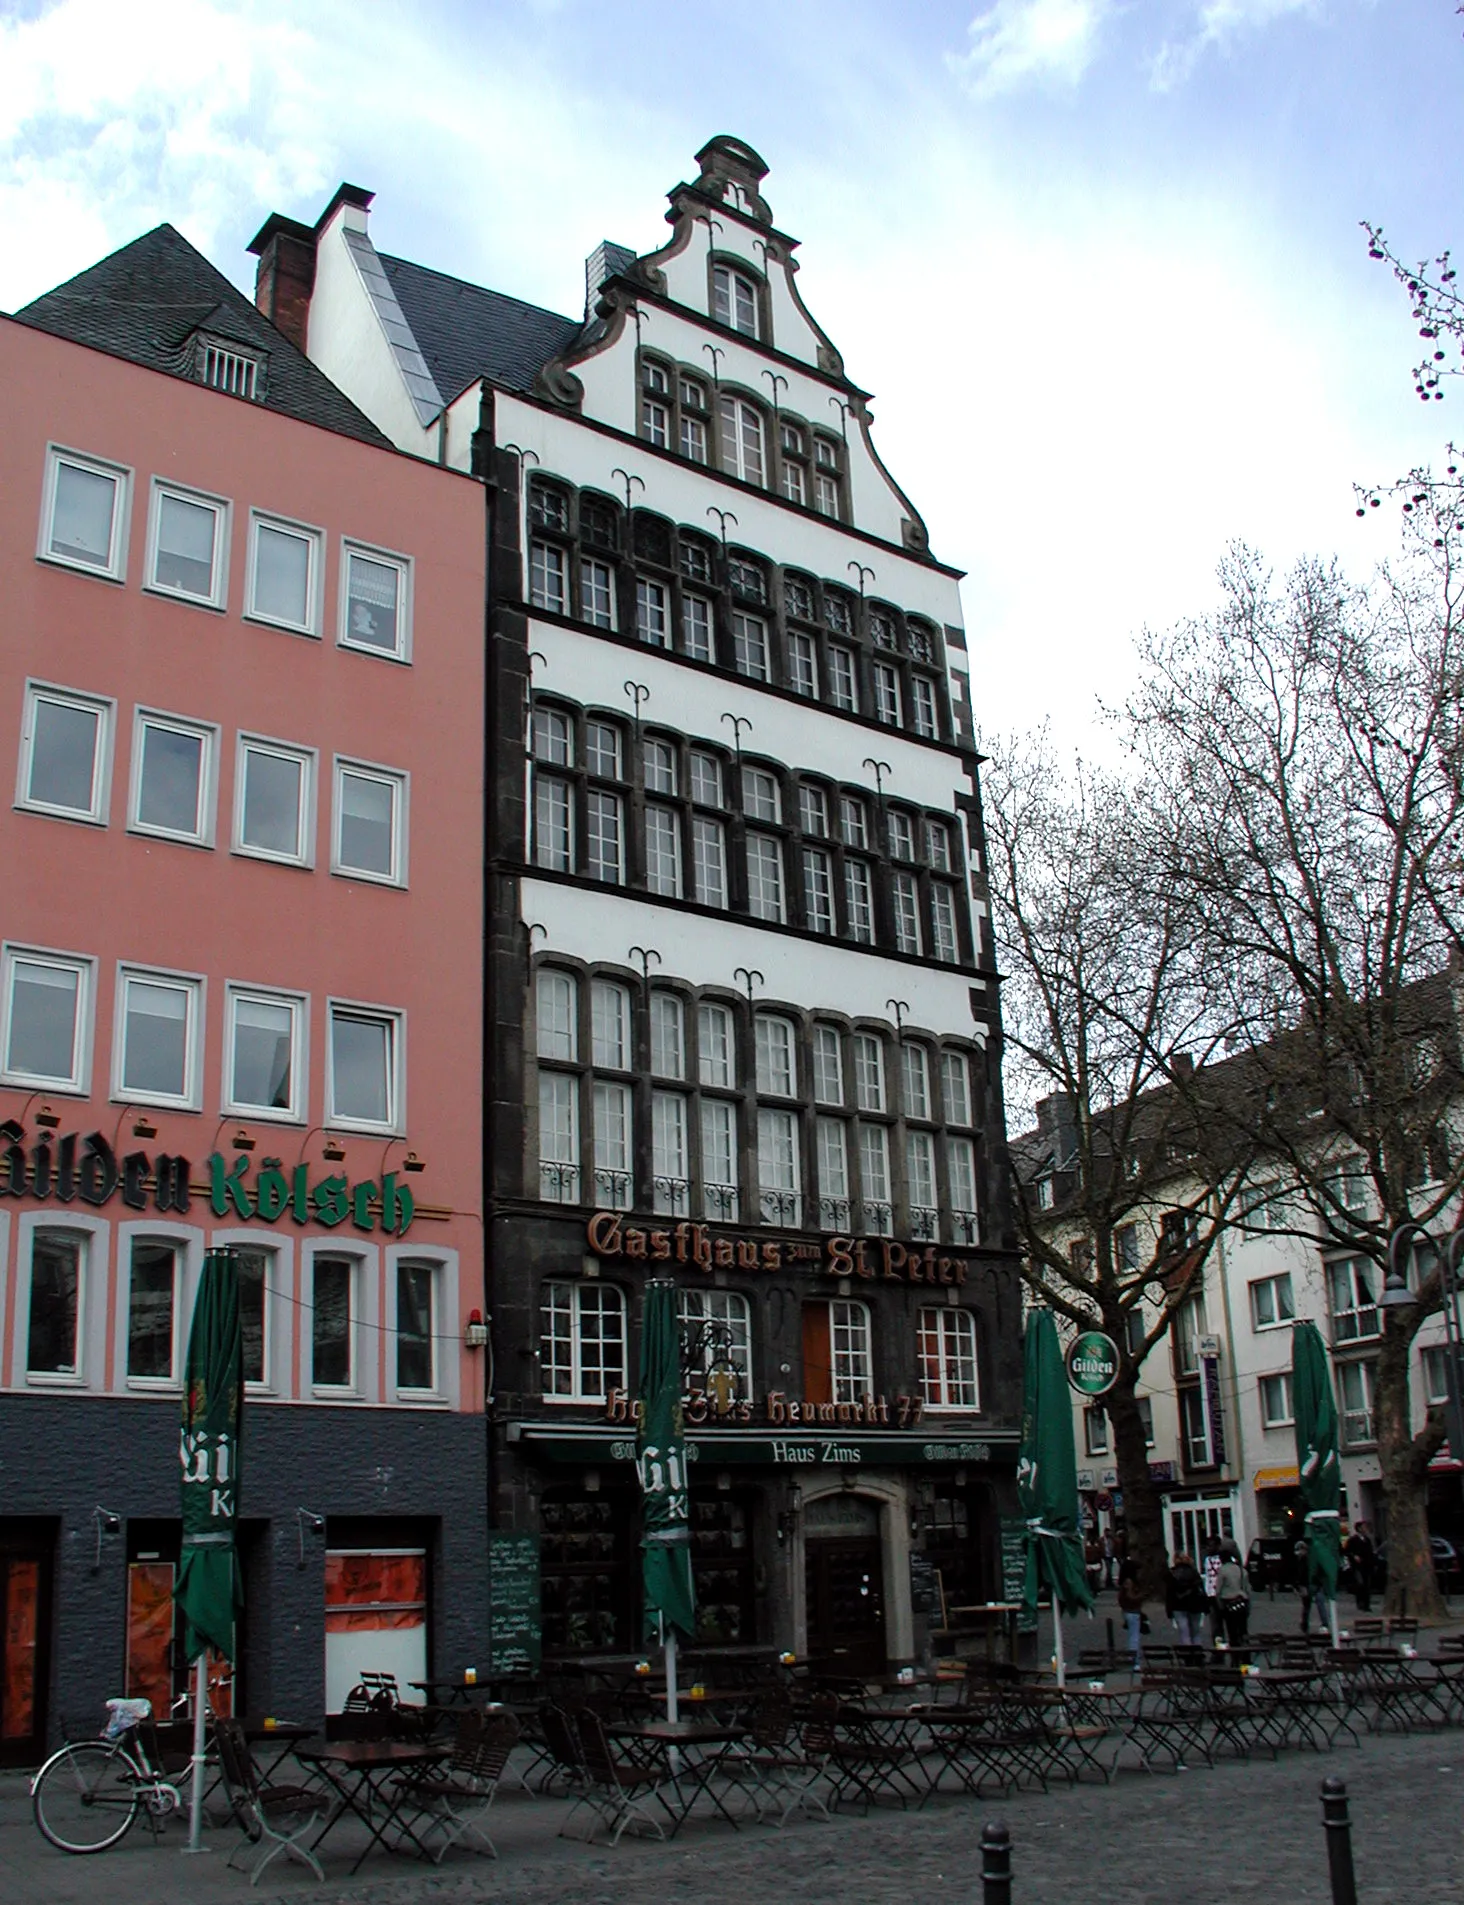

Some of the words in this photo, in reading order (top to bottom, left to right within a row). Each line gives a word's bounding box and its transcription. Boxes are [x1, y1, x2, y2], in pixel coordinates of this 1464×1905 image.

[207, 1150, 416, 1239] Kölsch
[586, 1211, 782, 1273] Gasthaus
[785, 1241, 822, 1263] zum
[880, 1238, 969, 1286] Peter
[1071, 1357, 1114, 1374] Gilden
[766, 1389, 890, 1425] Heumarkt
[896, 1395, 925, 1425] 77
[771, 1439, 816, 1464] Haus
[821, 1440, 862, 1464] Zims
